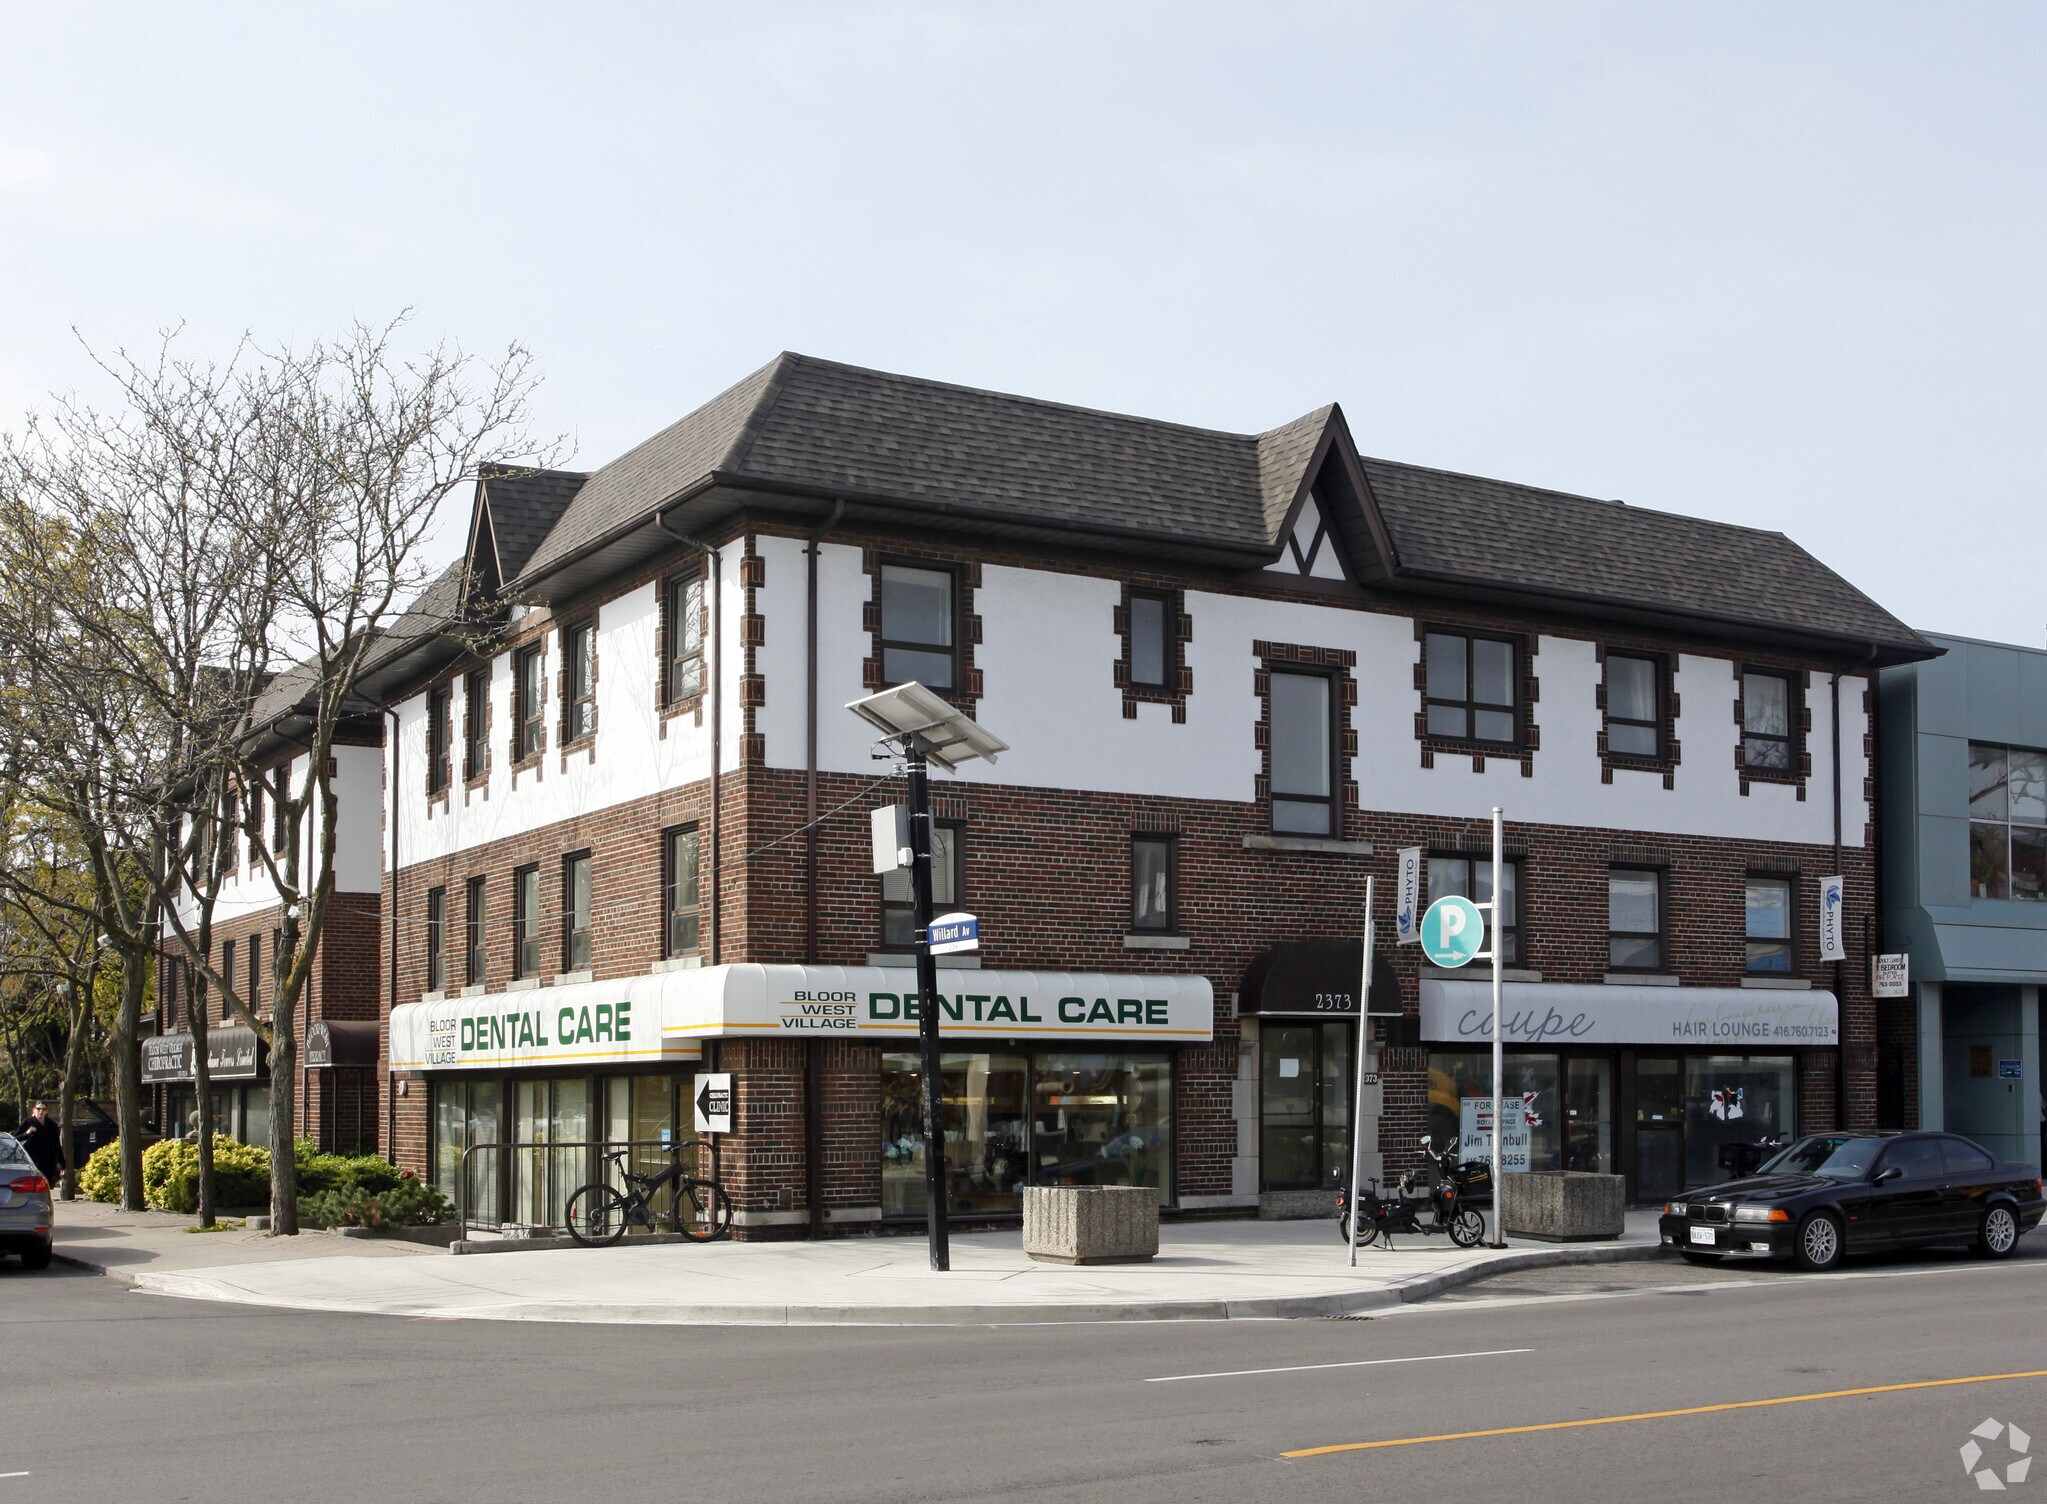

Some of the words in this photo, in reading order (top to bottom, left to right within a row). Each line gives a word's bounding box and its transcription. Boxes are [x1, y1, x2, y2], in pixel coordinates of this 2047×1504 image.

[1406, 859, 1414, 904] PHYTO
[932, 925, 958, 941] Willard
[962, 926, 970, 937] Av
[1440, 904, 1466, 948] P
[1826, 911, 1834, 951] PHYTO
[1880, 963, 1906, 971] BEDROOM
[794, 991, 856, 1002] BLOOR
[1315, 993, 1352, 1010] 2373
[801, 1004, 856, 1015] WEST
[868, 992, 1042, 1023] DENTAL
[1058, 997, 1169, 1025] CARE
[430, 1018, 457, 1033] BLOOR
[461, 1010, 549, 1051] DENTAL
[558, 1001, 632, 1045] CARE
[780, 1018, 857, 1029] VILLAGE
[1458, 1006, 1595, 1041] coupe
[1673, 1022, 1707, 1036] HAIR
[1713, 1022, 1770, 1037] LOUNGE
[1773, 1026, 1829, 1038] 416.760.7123
[432, 1035, 456, 1048] WEST
[425, 1052, 456, 1064] VILLAGE
[1365, 1074, 1378, 1083] 373
[709, 1101, 729, 1112] CLINIC
[1474, 1101, 1491, 1110] FOR
[1464, 1134, 1483, 1147] Jim
[1486, 1133, 1528, 1146] Tnbull
